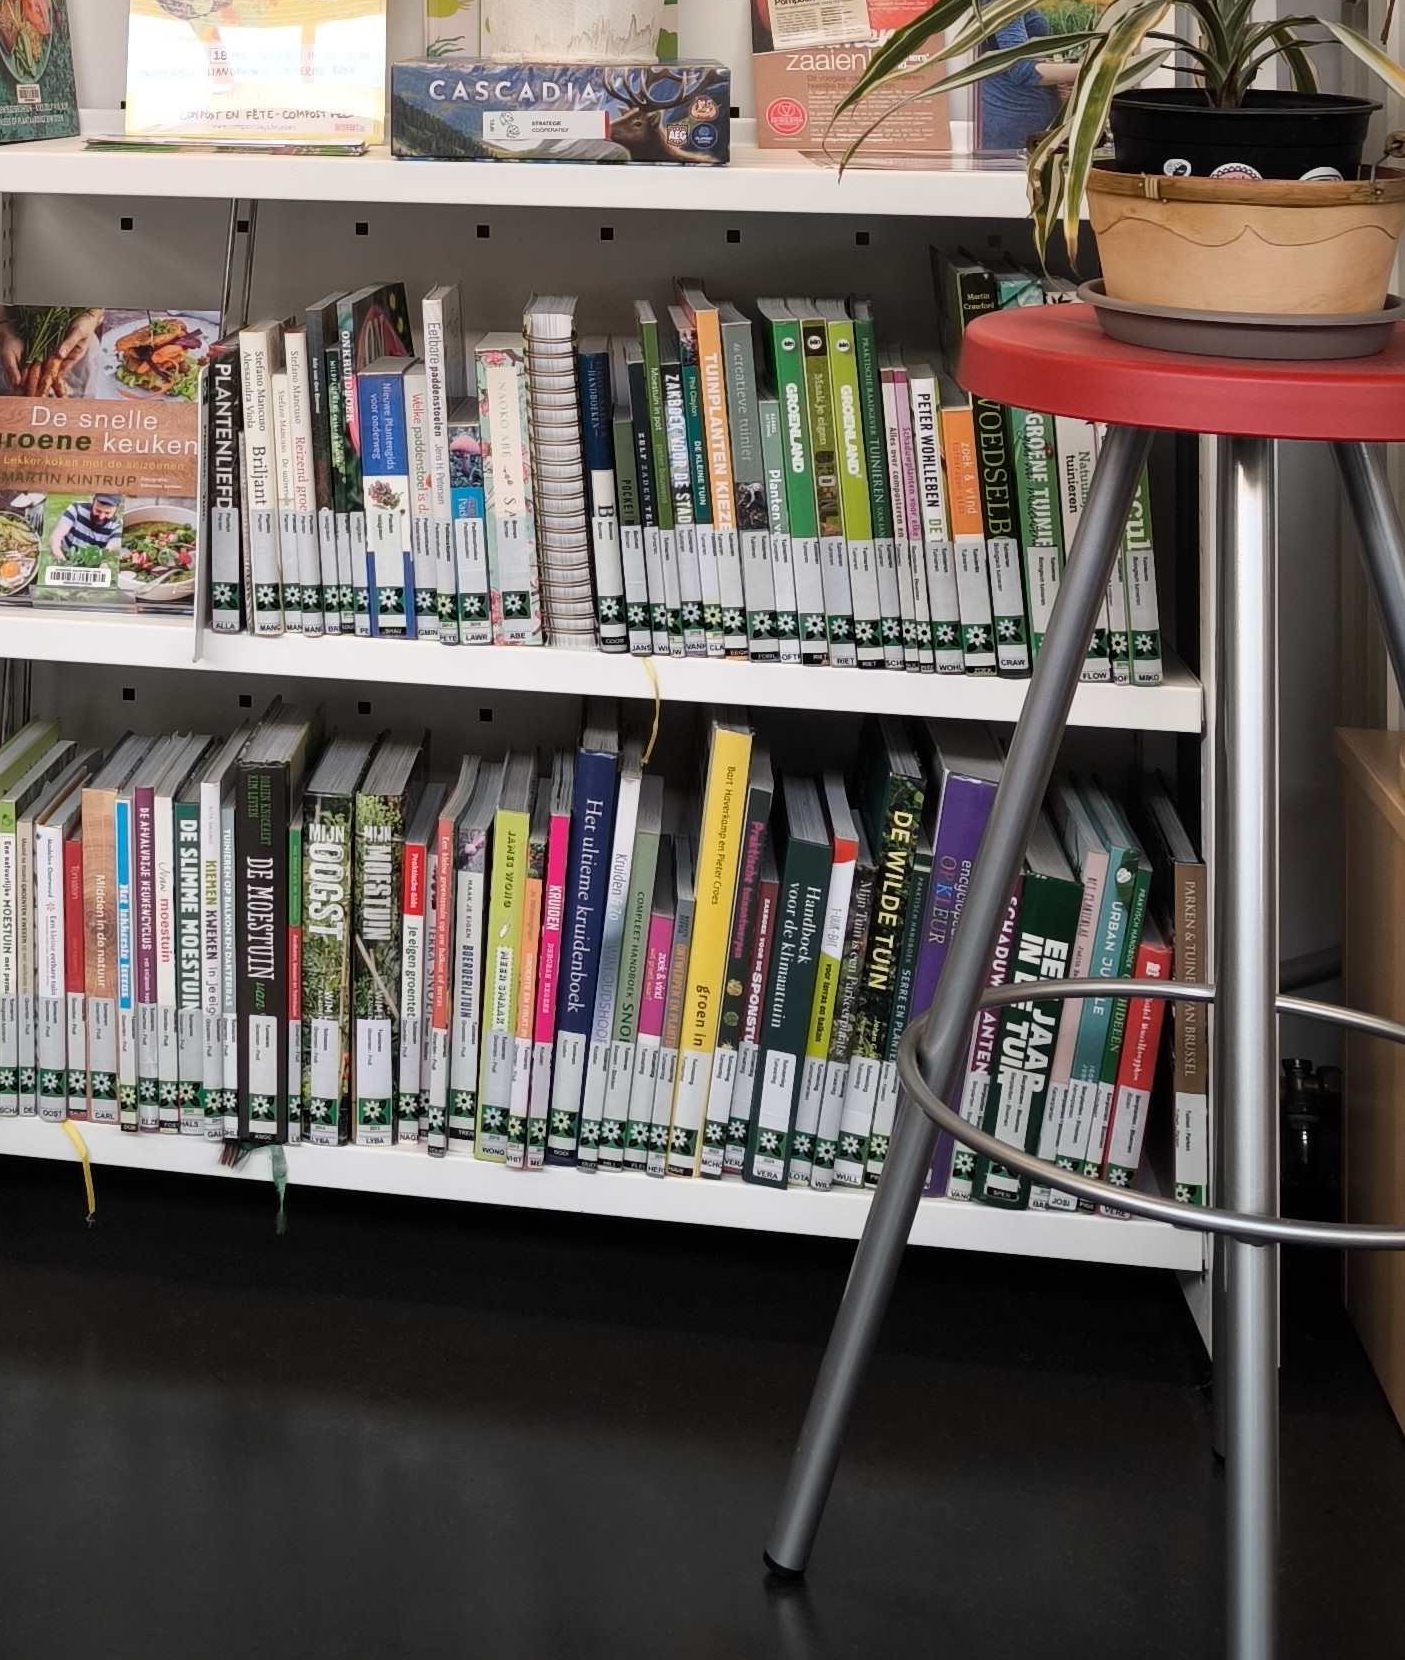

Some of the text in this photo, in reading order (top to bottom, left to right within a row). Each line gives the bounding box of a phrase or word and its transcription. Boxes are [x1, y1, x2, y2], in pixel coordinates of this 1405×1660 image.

[429, 80, 598, 102] CASCADIA
[669, 131, 686, 140] AEG
[967, 292, 990, 301] Martin
[427, 322, 442, 437] Eetbare paddenstoelen
[31, 406, 158, 430] De snelle
[251, 351, 268, 507] Stefano Mancuso Briljant
[370, 393, 382, 460] voor onderweg
[382, 382, 395, 471] Nieuwe Plantengids
[704, 352, 729, 468] TUINPLANTEN
[785, 383, 805, 473] GROENLAND
[917, 392, 932, 440] PETER
[103, 432, 198, 454] keuken
[664, 373, 692, 524] ZAKBOEK VOOR DE STAD
[1, 472, 137, 486] MARTIN KINTRUP
[920, 443, 940, 509] WOHLLEBEN
[1065, 454, 1079, 515] tuinieren
[215, 621, 235, 631] ALLA
[465, 632, 489, 641] LAWR
[938, 664, 962, 672] WOHL
[1000, 658, 1025, 667] CRAW
[309, 824, 345, 940] MIJN OOGST
[566, 798, 604, 1014] Het ultieme kruidenboek
[787, 882, 800, 915] voor
[868, 811, 912, 990] DE WILDE TUIN
[1185, 881, 1196, 927] PARKEN
[178, 819, 201, 1010] DE SLIMME MOESTUIN
[246, 856, 276, 982] DE MOESTUIN
[546, 885, 562, 931] KRUIDEN
[798, 886, 822, 964] Handboek
[1102, 902, 1122, 953] URBAN
[695, 985, 708, 1029] groen
[770, 941, 793, 1028] klimaattuin
[1184, 1032, 1197, 1077] BRUSSEL
